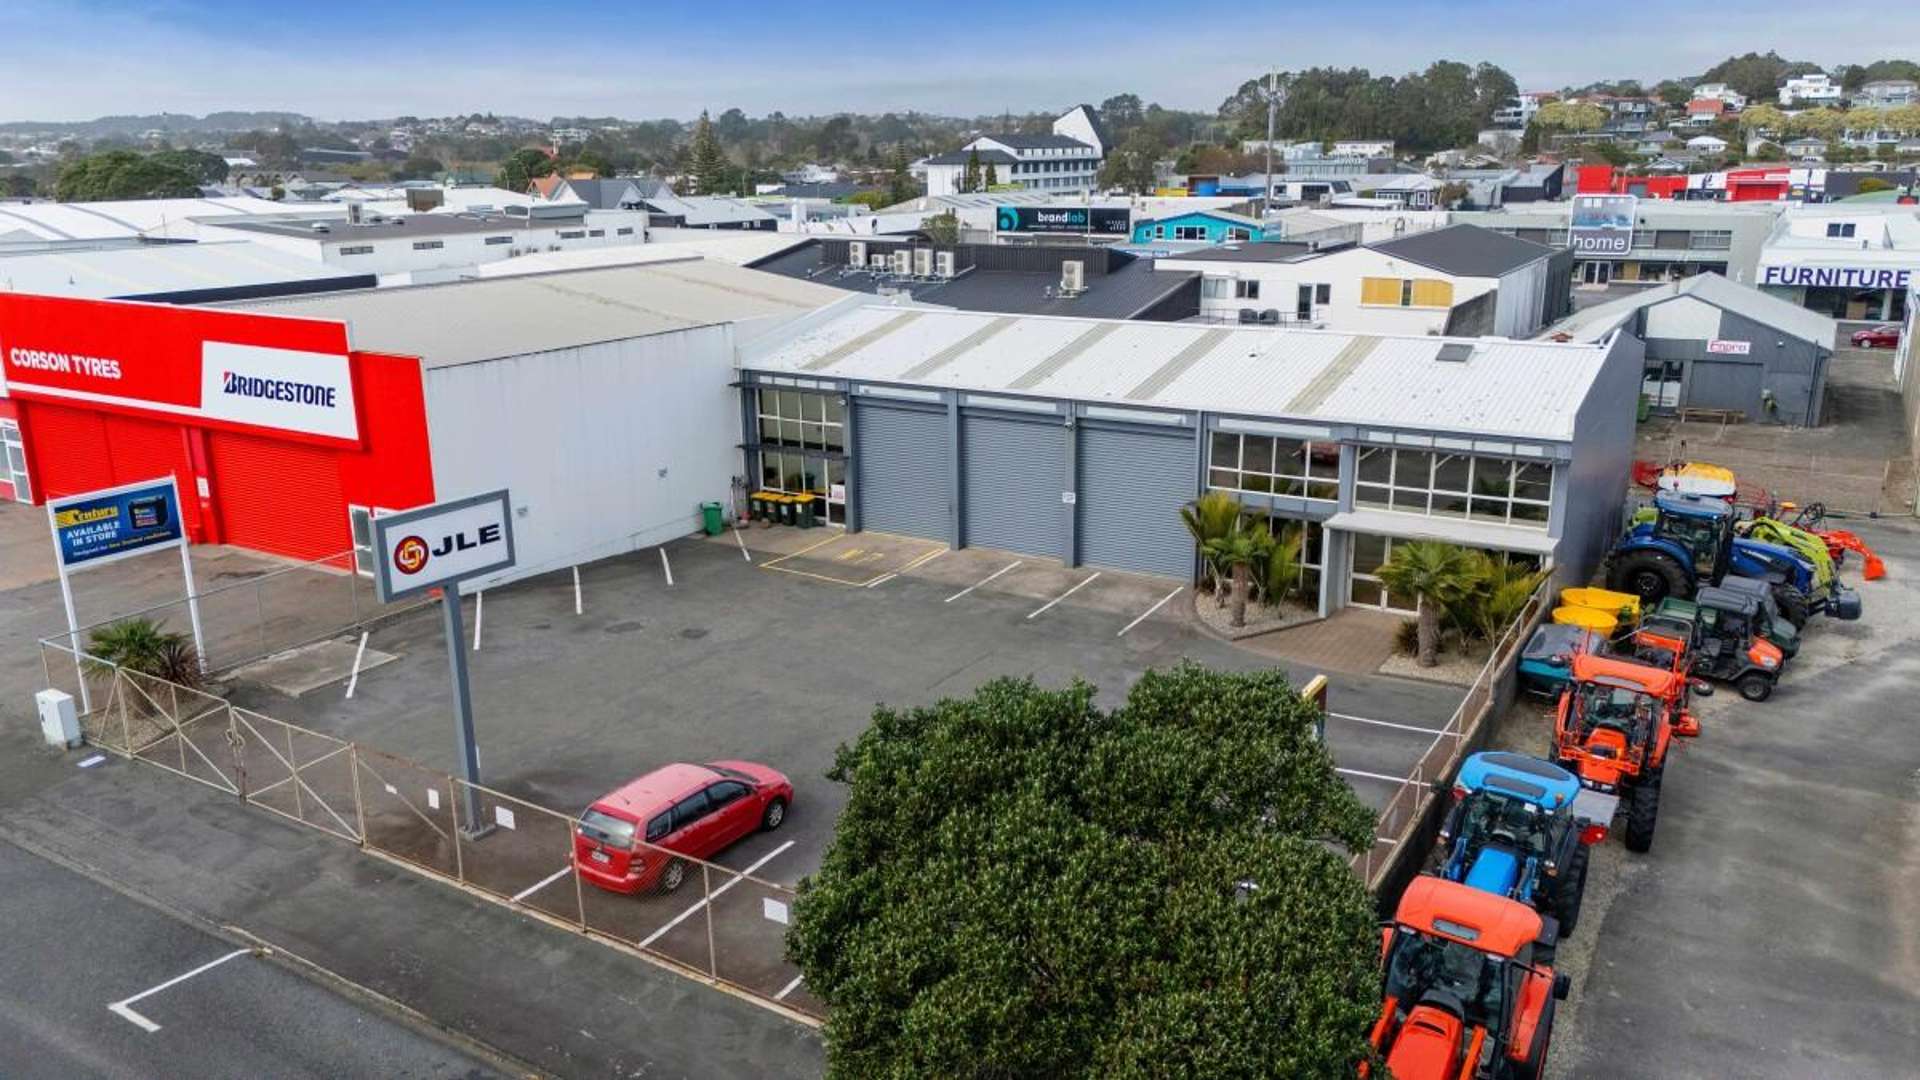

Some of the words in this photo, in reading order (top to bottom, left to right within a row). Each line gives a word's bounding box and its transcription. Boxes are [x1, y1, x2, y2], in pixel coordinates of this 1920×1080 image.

[1037, 211, 1086, 222] brandlab
[1573, 234, 1625, 250] home
[1765, 266, 1911, 288] FURNITURE
[10, 347, 71, 373] CORSON
[71, 354, 122, 379] TYRES
[223, 371, 336, 408] BRIDGESTONE
[66, 521, 121, 539] AVAILABLE
[72, 537, 83, 547] IN
[86, 531, 117, 544] STORE
[432, 523, 501, 557] JLE
